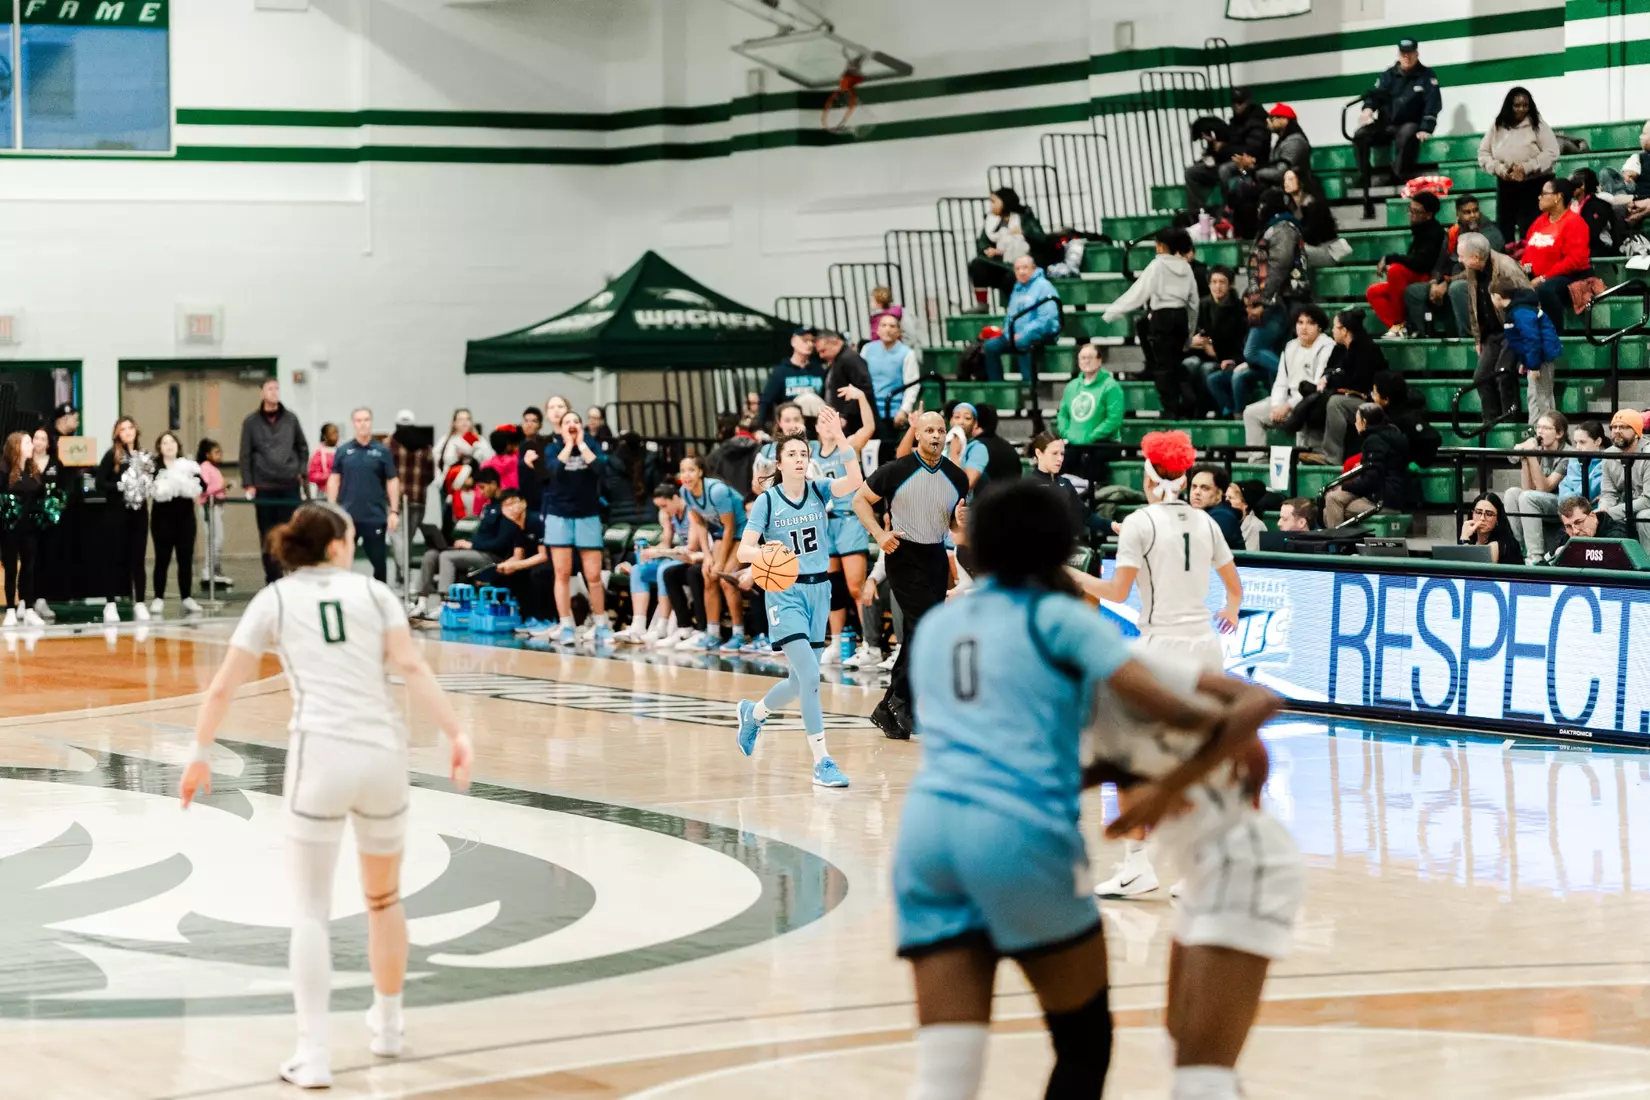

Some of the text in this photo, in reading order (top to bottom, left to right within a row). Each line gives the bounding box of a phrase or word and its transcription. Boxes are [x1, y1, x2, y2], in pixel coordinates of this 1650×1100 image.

[24, 0, 161, 22] FAME
[633, 309, 772, 328] WAGNER
[774, 511, 823, 528] COLUMBIA
[789, 526, 819, 556] 12
[1182, 532, 1190, 571] 1
[1585, 549, 1604, 561] POSS
[319, 601, 346, 643] 0
[768, 605, 780, 626] C
[952, 639, 979, 702] 0
[1559, 729, 1593, 737] DAKTRONICS
